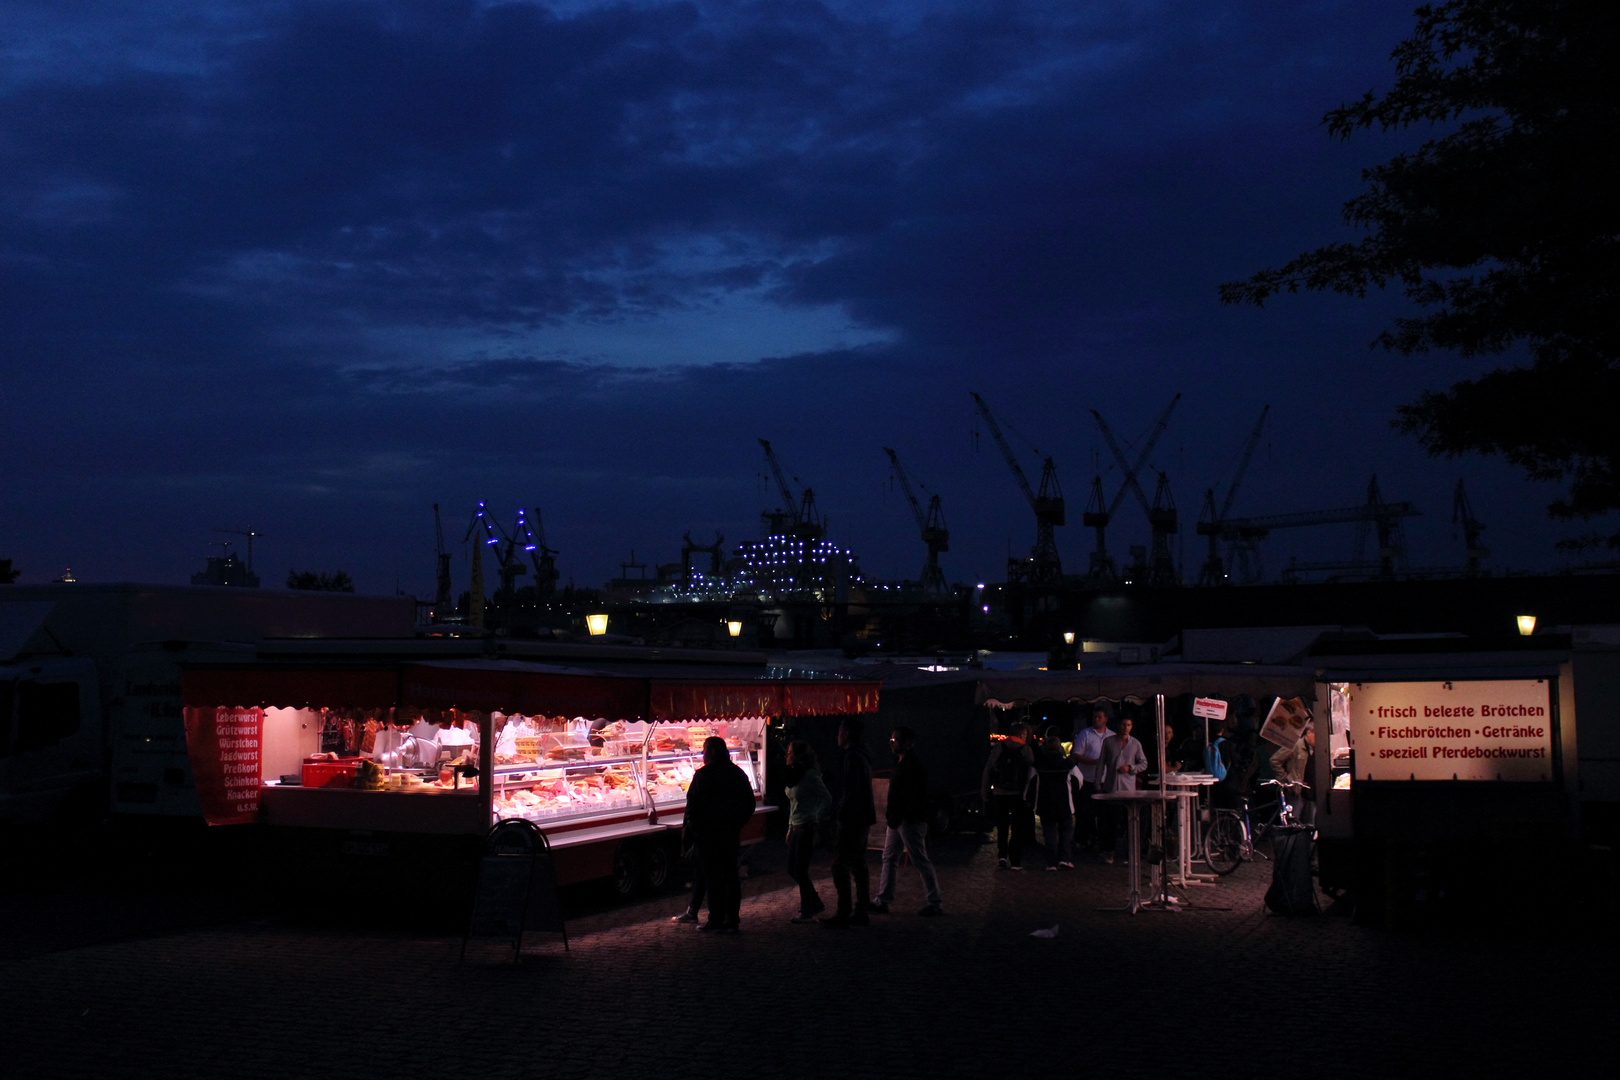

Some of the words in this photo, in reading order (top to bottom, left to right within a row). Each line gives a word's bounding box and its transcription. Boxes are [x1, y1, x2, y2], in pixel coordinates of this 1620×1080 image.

[1378, 705, 1417, 718] frisch
[1424, 705, 1475, 717] belegte
[1481, 704, 1544, 717] Brötchen
[216, 712, 258, 723] Leberwurst
[216, 725, 258, 736] Grützwurst
[1378, 725, 1471, 738] Fischbrötchen
[1482, 725, 1544, 738] Getränke
[219, 738, 258, 748] Würstchen
[220, 751, 258, 761] Jagdwurst
[1379, 746, 1427, 759] speziell
[1432, 746, 1545, 759] Pferdebockwurst
[223, 764, 259, 774] Preßkopf
[224, 777, 259, 787] Schinken
[227, 789, 258, 800] Knacker
